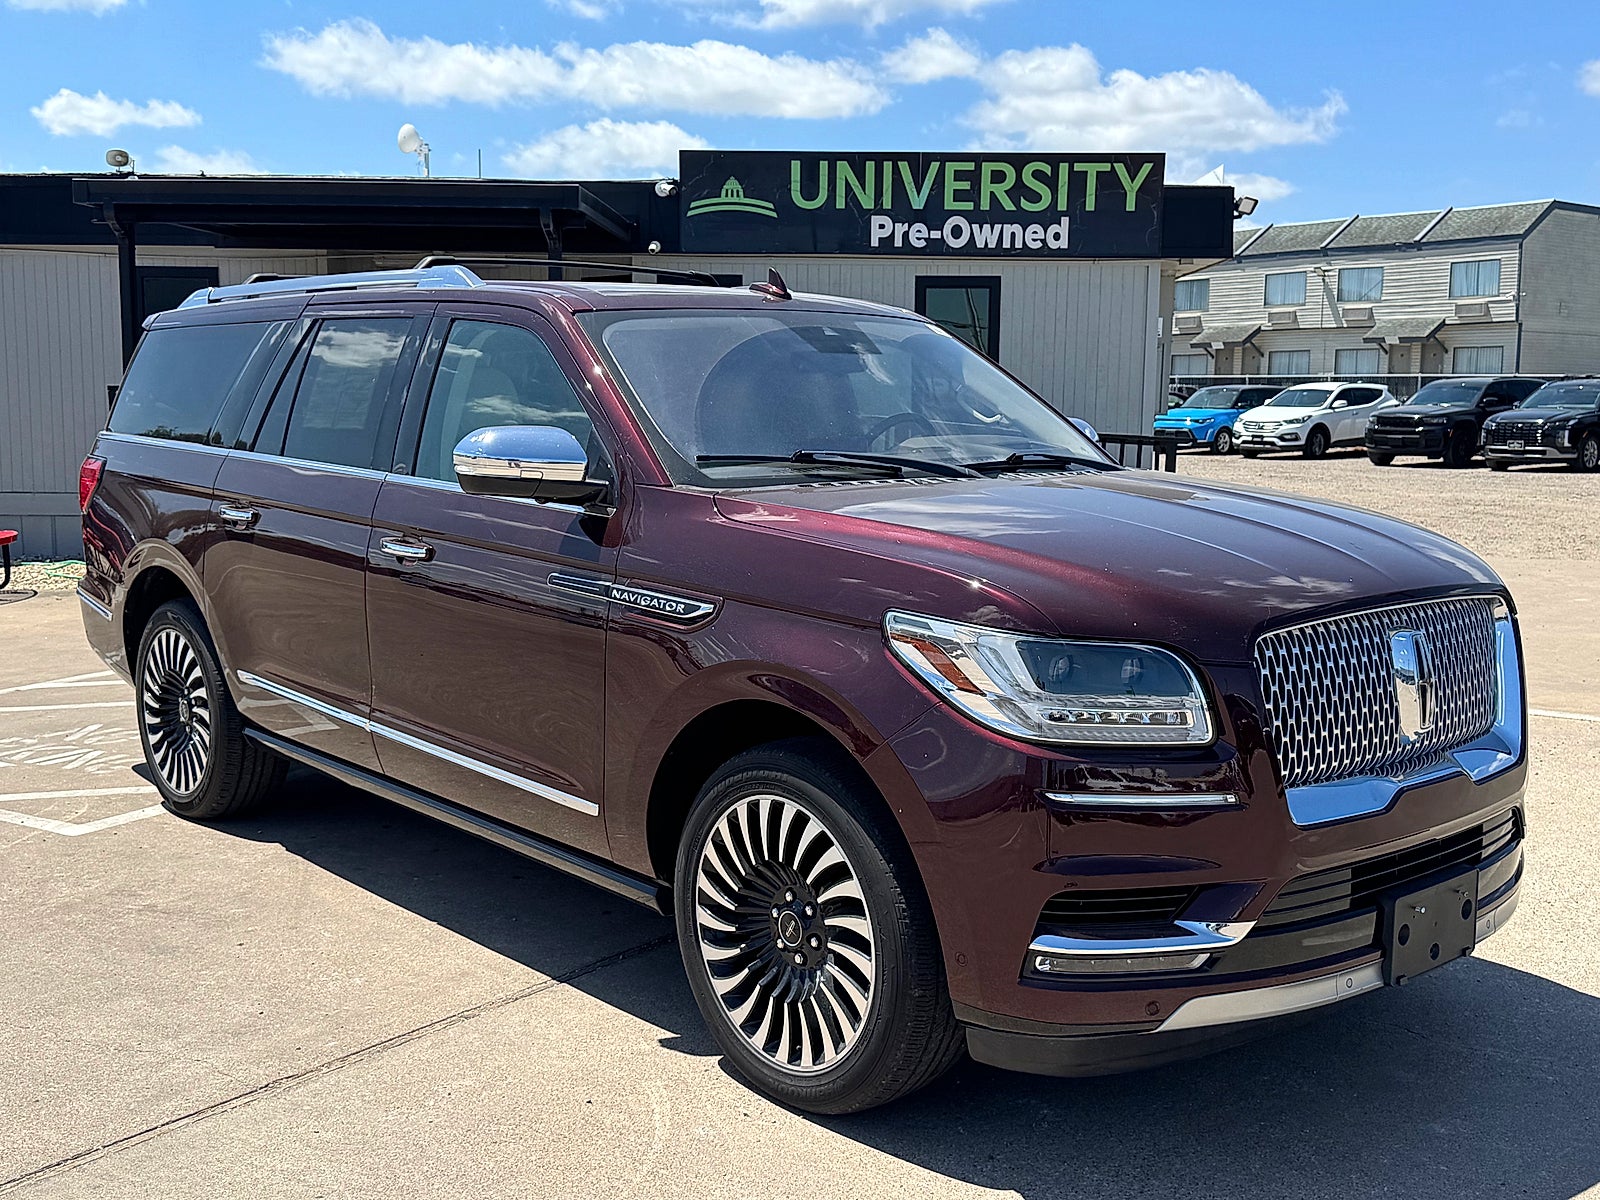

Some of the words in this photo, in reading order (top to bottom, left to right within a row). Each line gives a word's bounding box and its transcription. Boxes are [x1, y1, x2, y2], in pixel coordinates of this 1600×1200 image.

[790, 160, 1153, 212] UNIVERSITY
[870, 215, 1069, 249] Pre-Owned
[611, 589, 685, 613] NAVIGATOR
